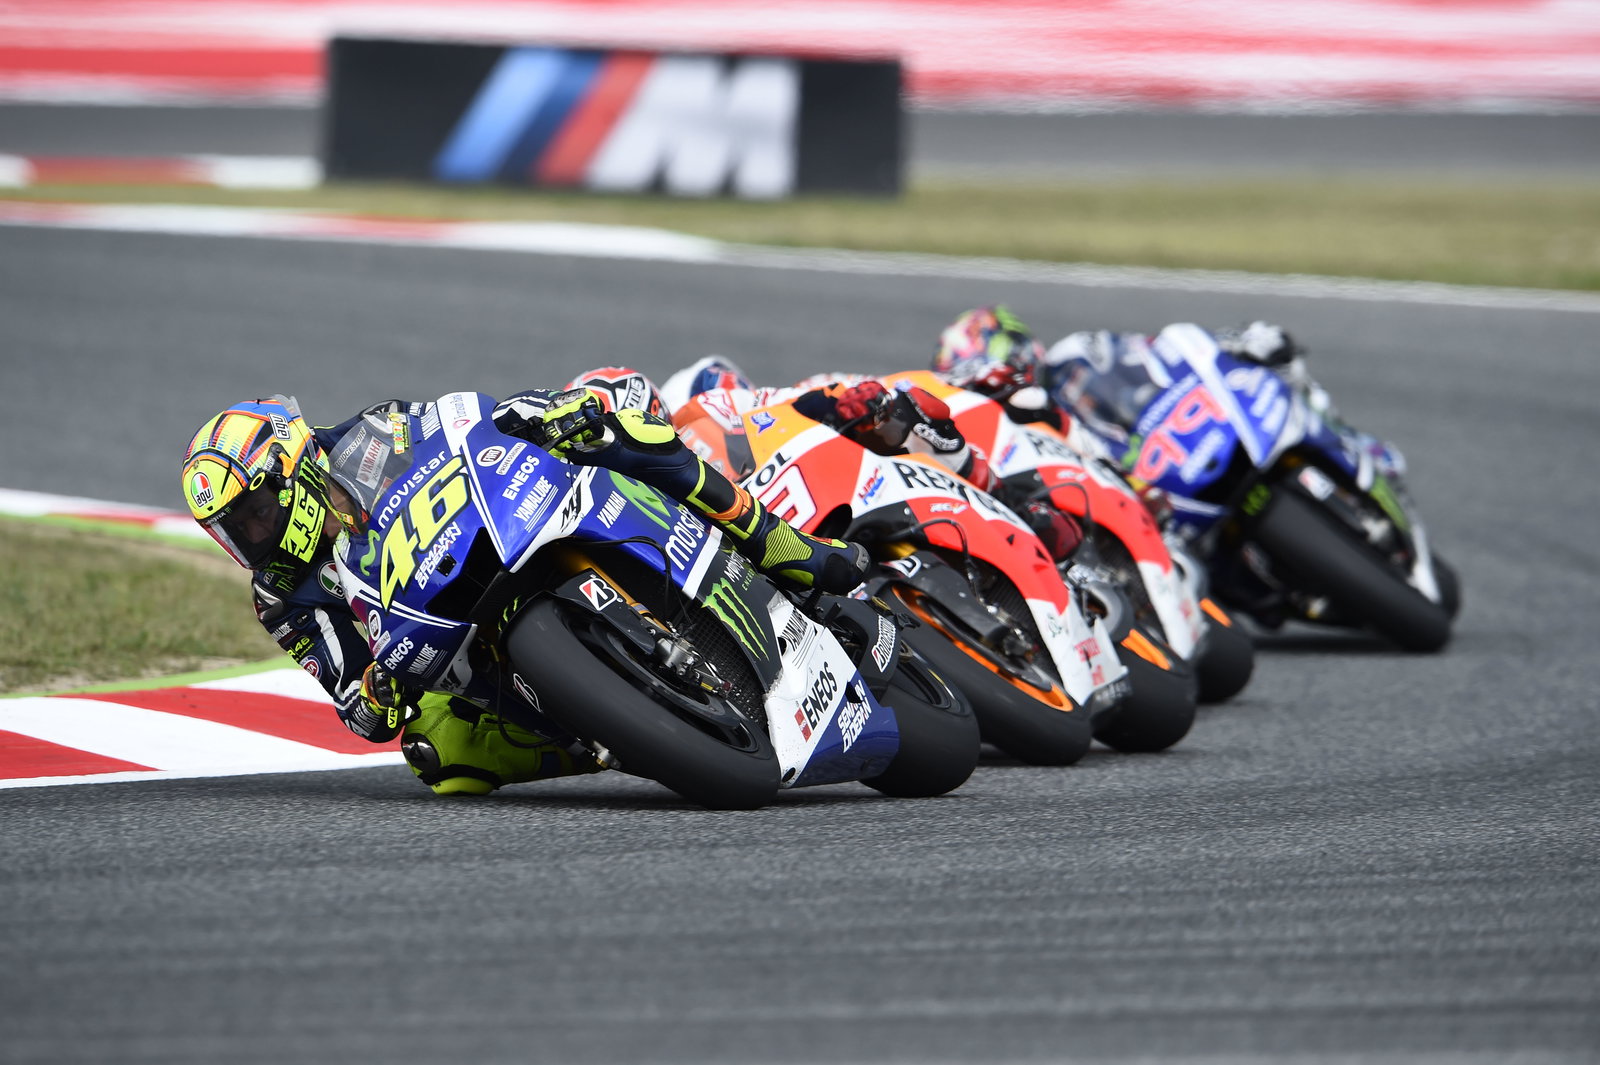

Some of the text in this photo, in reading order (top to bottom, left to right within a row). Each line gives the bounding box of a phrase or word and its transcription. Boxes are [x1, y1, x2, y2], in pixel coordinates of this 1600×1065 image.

[361, 439, 383, 474] YAMAHA
[502, 455, 540, 501] ENEOS
[377, 450, 447, 530] movistar
[513, 475, 553, 522] YAMALUBE
[596, 490, 628, 529] YAMAHA
[380, 454, 472, 612] 46
[384, 637, 414, 670] ENEOS
[801, 661, 838, 731] ENEOS
